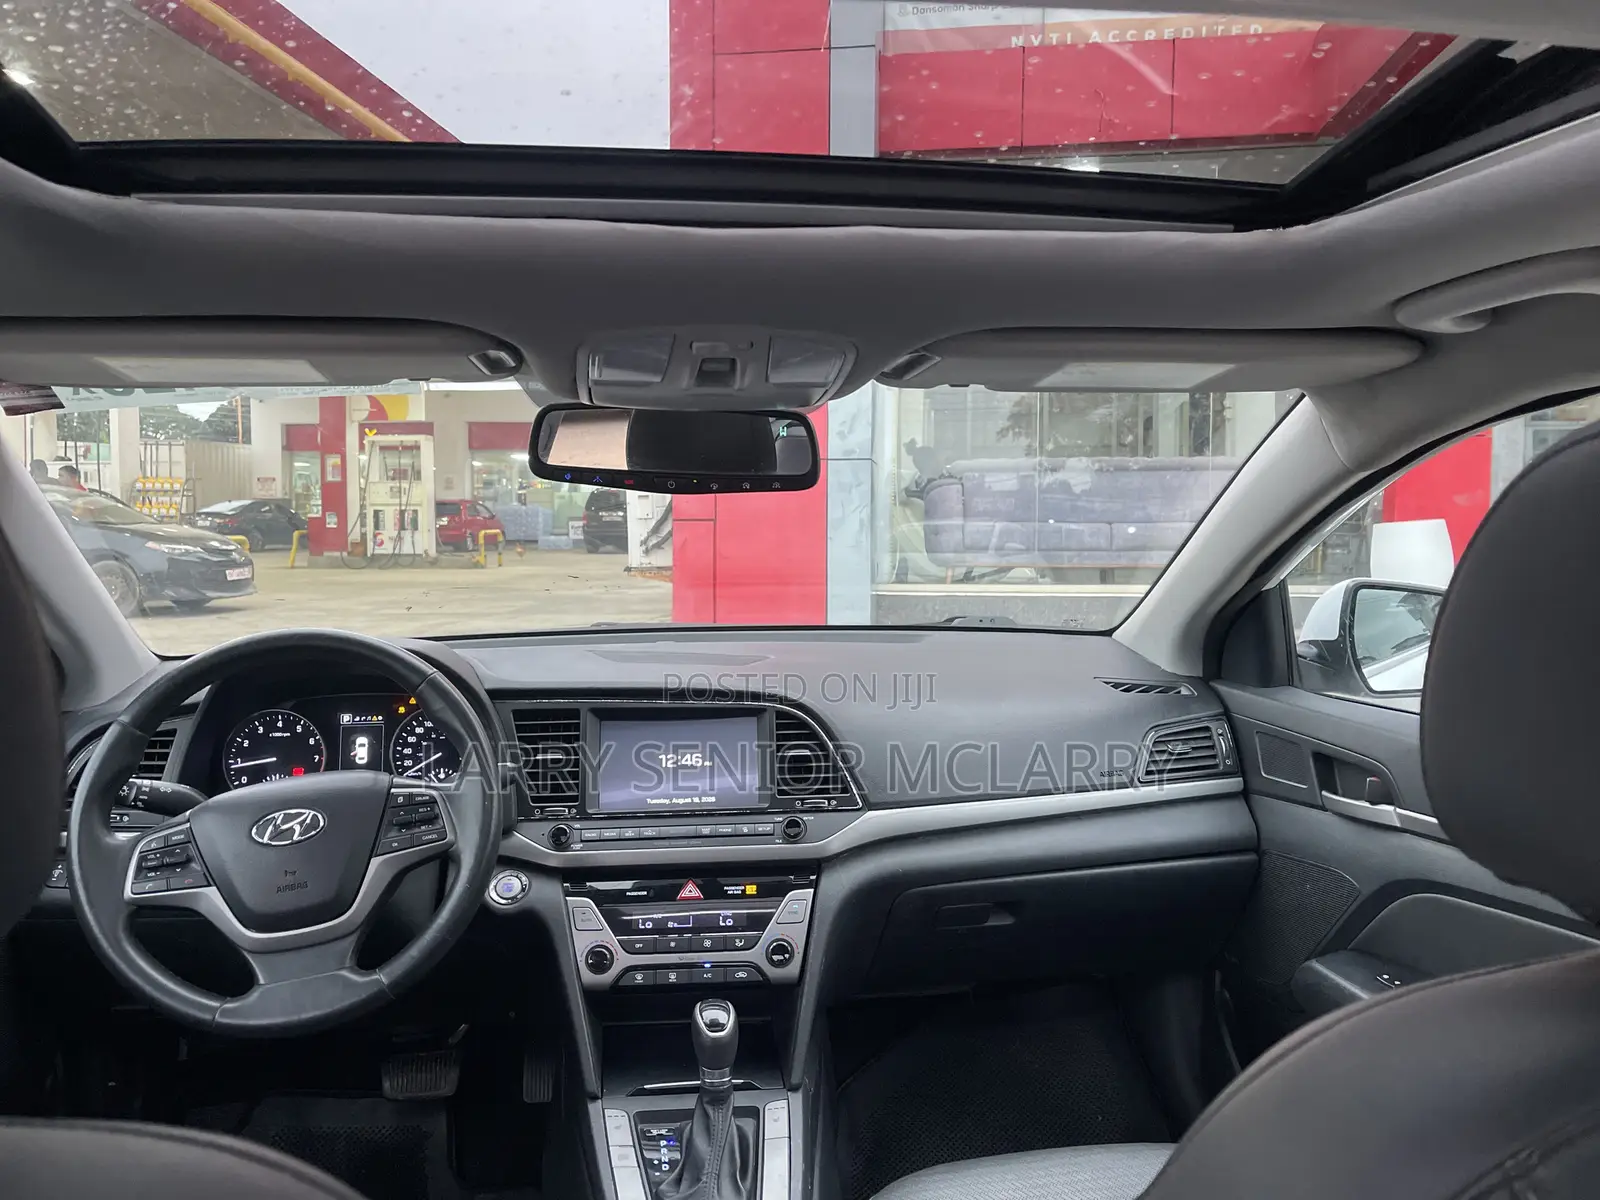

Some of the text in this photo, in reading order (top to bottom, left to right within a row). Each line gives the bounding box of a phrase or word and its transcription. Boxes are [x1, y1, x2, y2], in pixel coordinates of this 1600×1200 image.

[1010, 23, 1263, 47] NVTI ACCREDITED
[276, 720, 284, 728] 4
[257, 726, 265, 734] 3
[296, 725, 303, 733] 5
[243, 739, 250, 747] 2
[308, 737, 316, 745] 6
[402, 747, 413, 755] 40
[313, 755, 320, 763] 7
[403, 759, 413, 767] 20
[658, 753, 703, 768] 12:46
[241, 776, 248, 784] 0
[275, 880, 309, 894] AIRBAG
[661, 1163, 670, 1171] D
